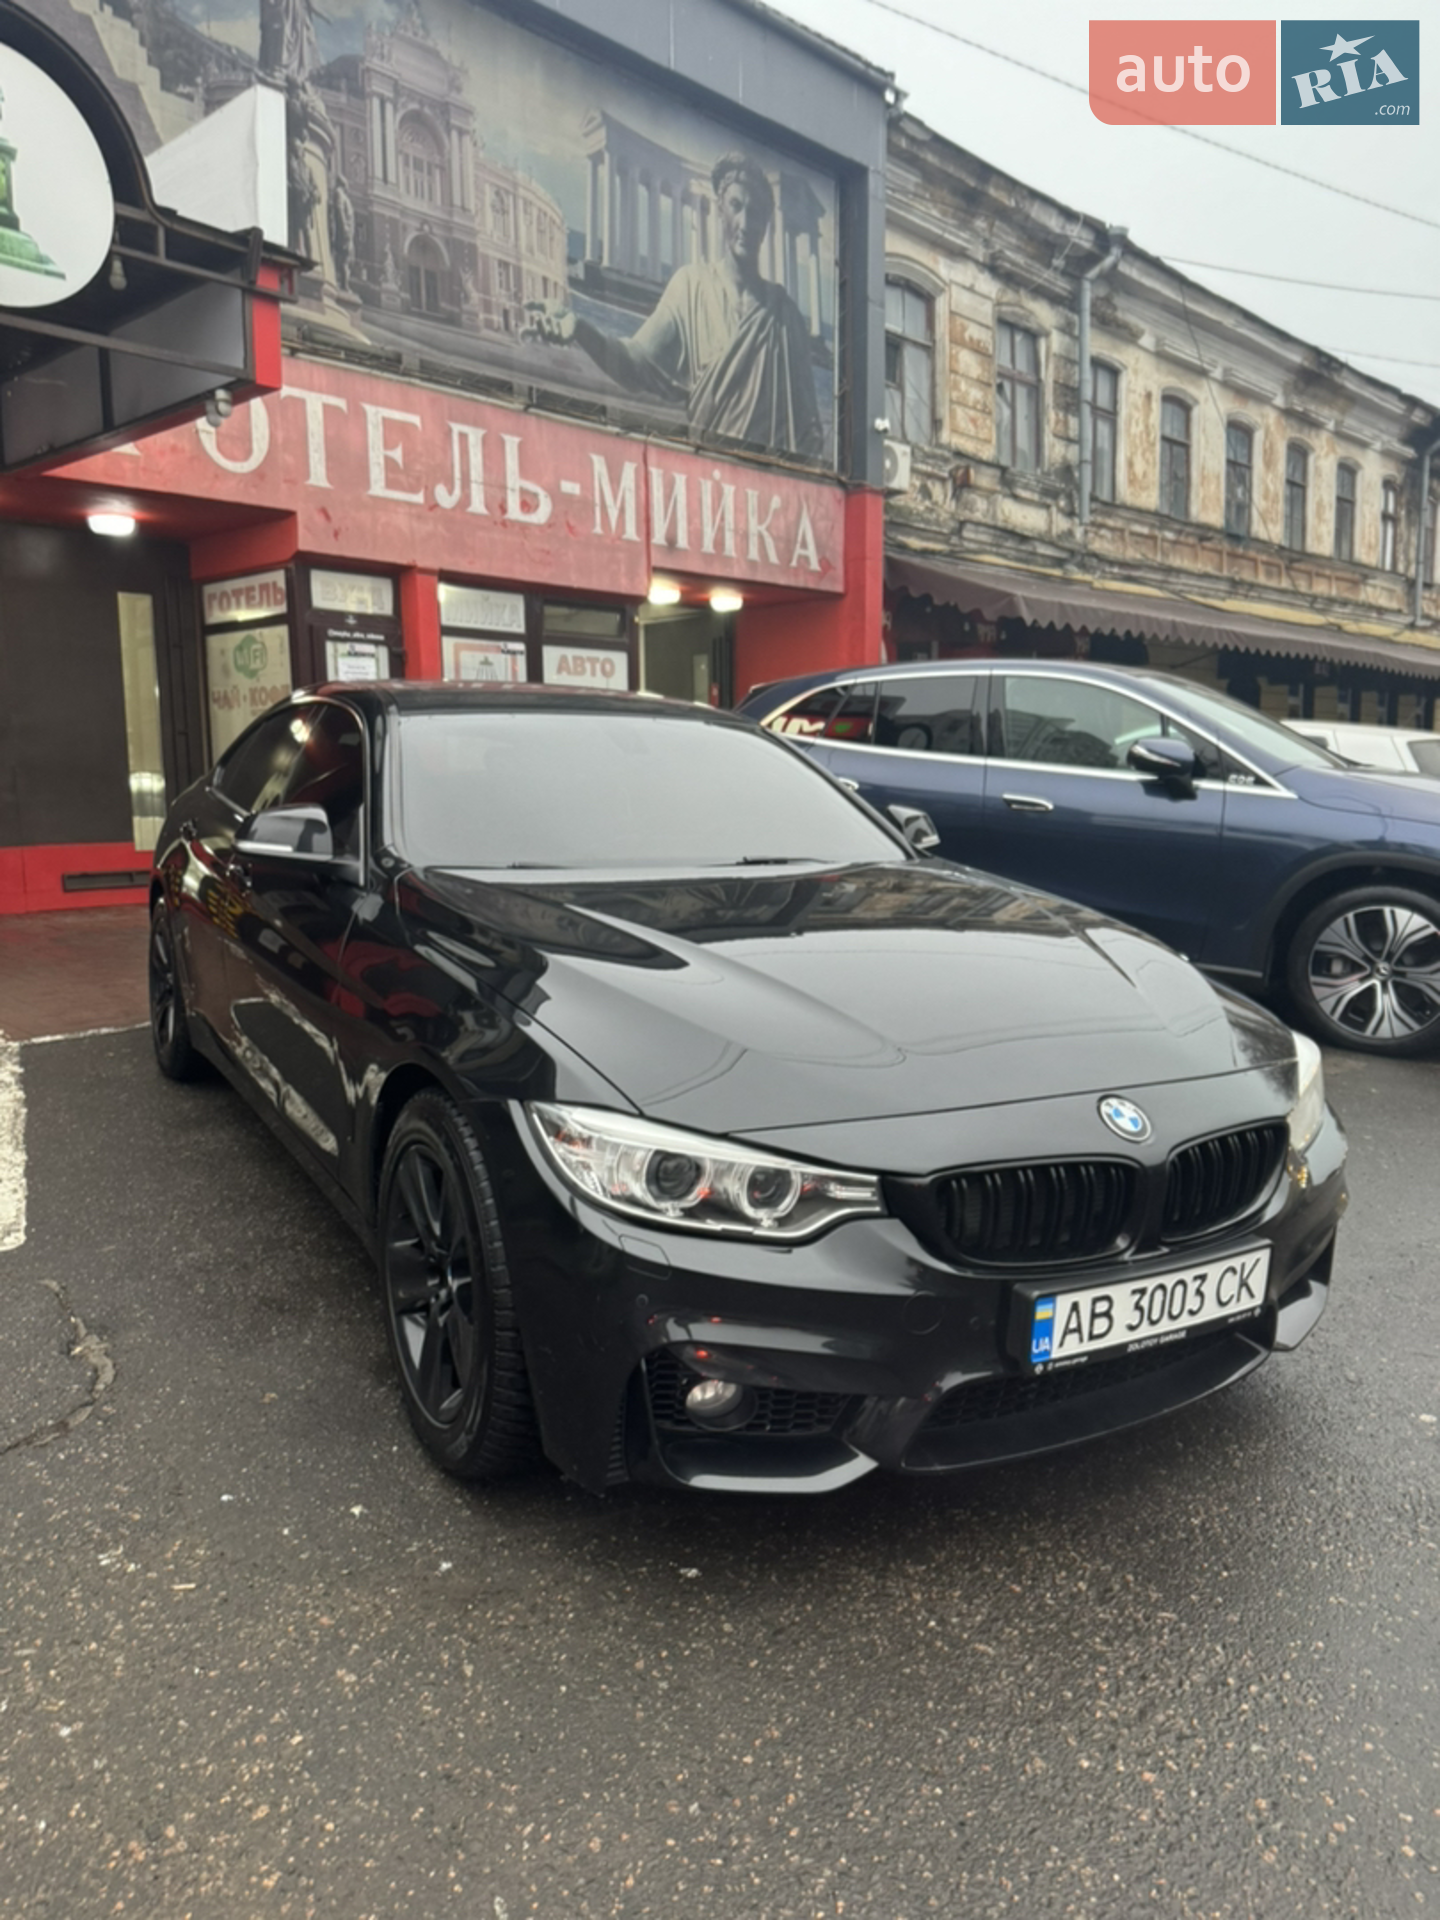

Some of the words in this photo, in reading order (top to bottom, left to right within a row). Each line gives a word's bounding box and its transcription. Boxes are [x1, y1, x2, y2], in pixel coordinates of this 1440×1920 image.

[112, 387, 823, 572] ОТЕЛЬ-МИЙКА
[206, 580, 286, 618] ГОТЕЛЬ
[556, 654, 616, 679] АВТО
[1057, 1294, 1115, 1349] AB
[1124, 1272, 1209, 1332] 3003
[1215, 1256, 1262, 1308] CK
[1032, 1336, 1051, 1354] UA
